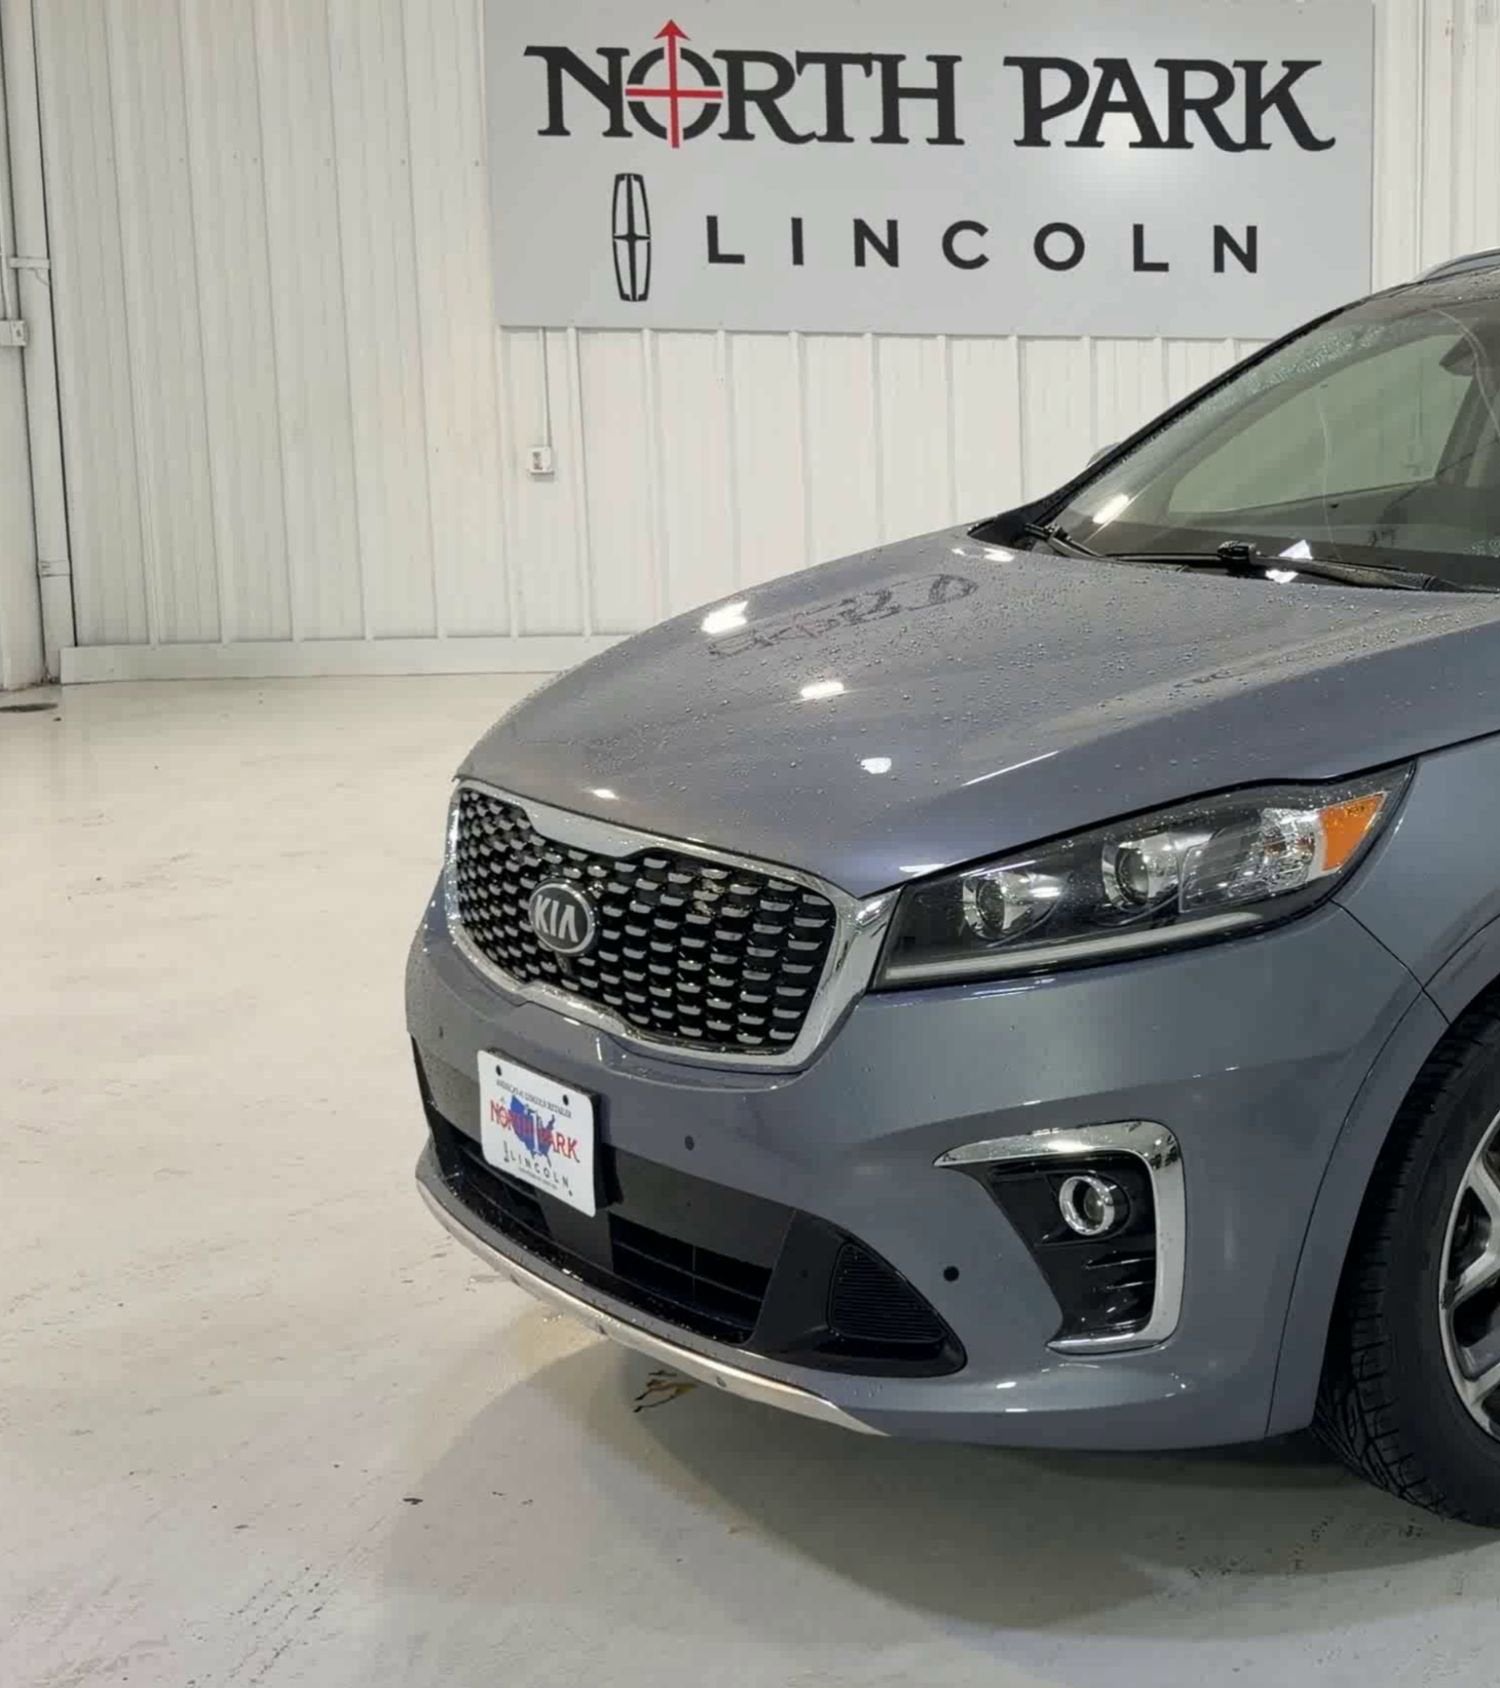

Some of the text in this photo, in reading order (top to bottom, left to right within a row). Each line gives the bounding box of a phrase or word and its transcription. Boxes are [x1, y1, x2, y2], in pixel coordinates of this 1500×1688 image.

[524, 45, 1337, 153] NORTH PARK
[706, 215, 1259, 274] LINCOLN
[535, 894, 579, 943] KIA
[510, 1150, 569, 1188] LINCOLN
